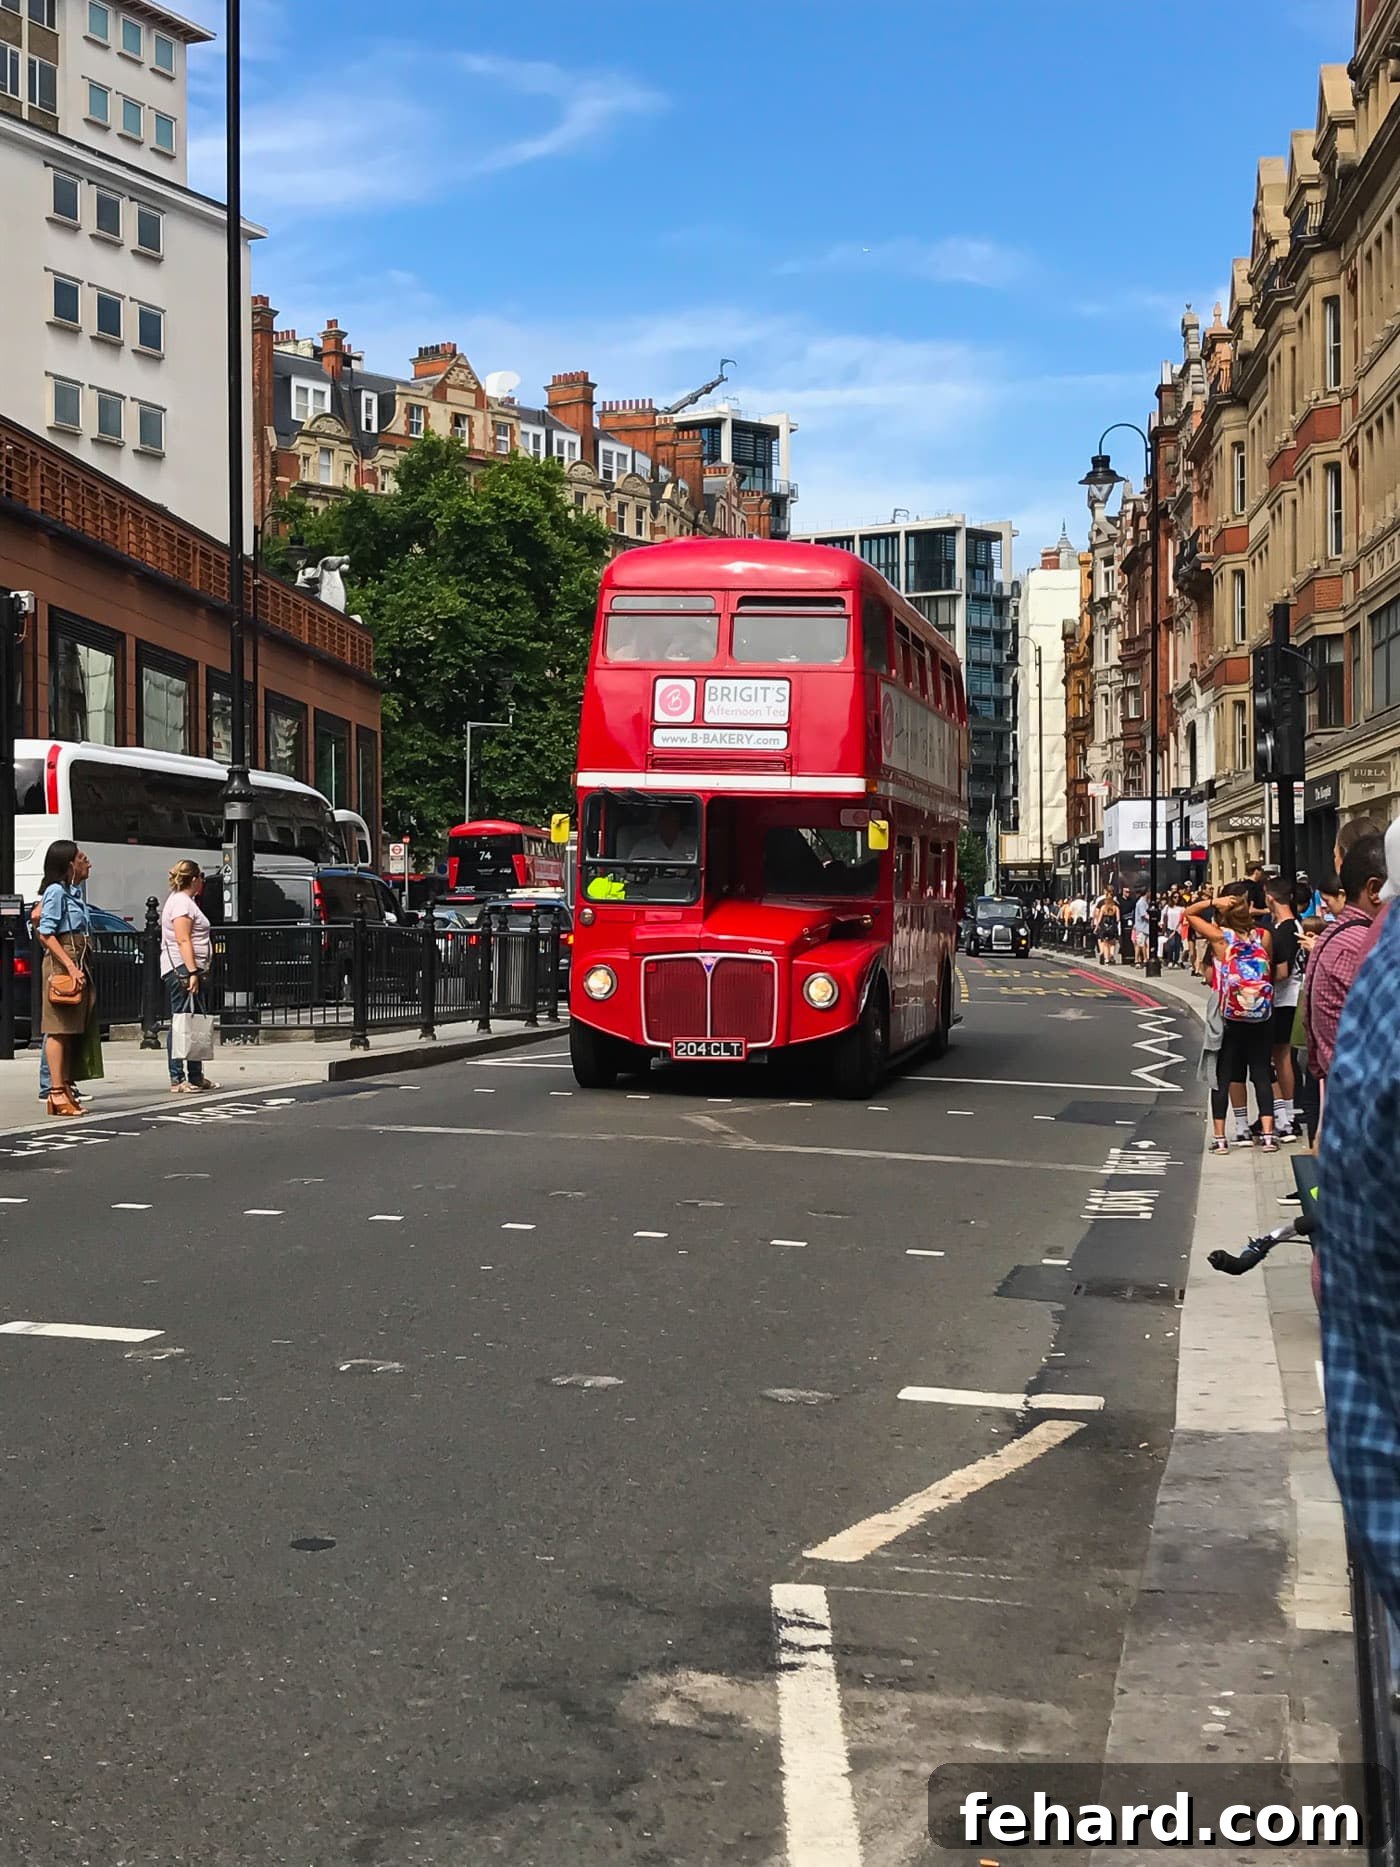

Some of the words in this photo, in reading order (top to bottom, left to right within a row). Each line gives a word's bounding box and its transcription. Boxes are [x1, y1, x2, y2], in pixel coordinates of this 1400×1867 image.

[708, 686, 787, 703] BRIGIT'S
[708, 704, 762, 717] Afternoon
[766, 706, 786, 717] Tea
[1354, 768, 1387, 777] FURLA
[480, 851, 492, 861] 74
[677, 1042, 706, 1056] 204
[710, 1042, 741, 1056] CLT
[1099, 1148, 1175, 1175] RIGHT
[1080, 1189, 1160, 1219] LOOK
